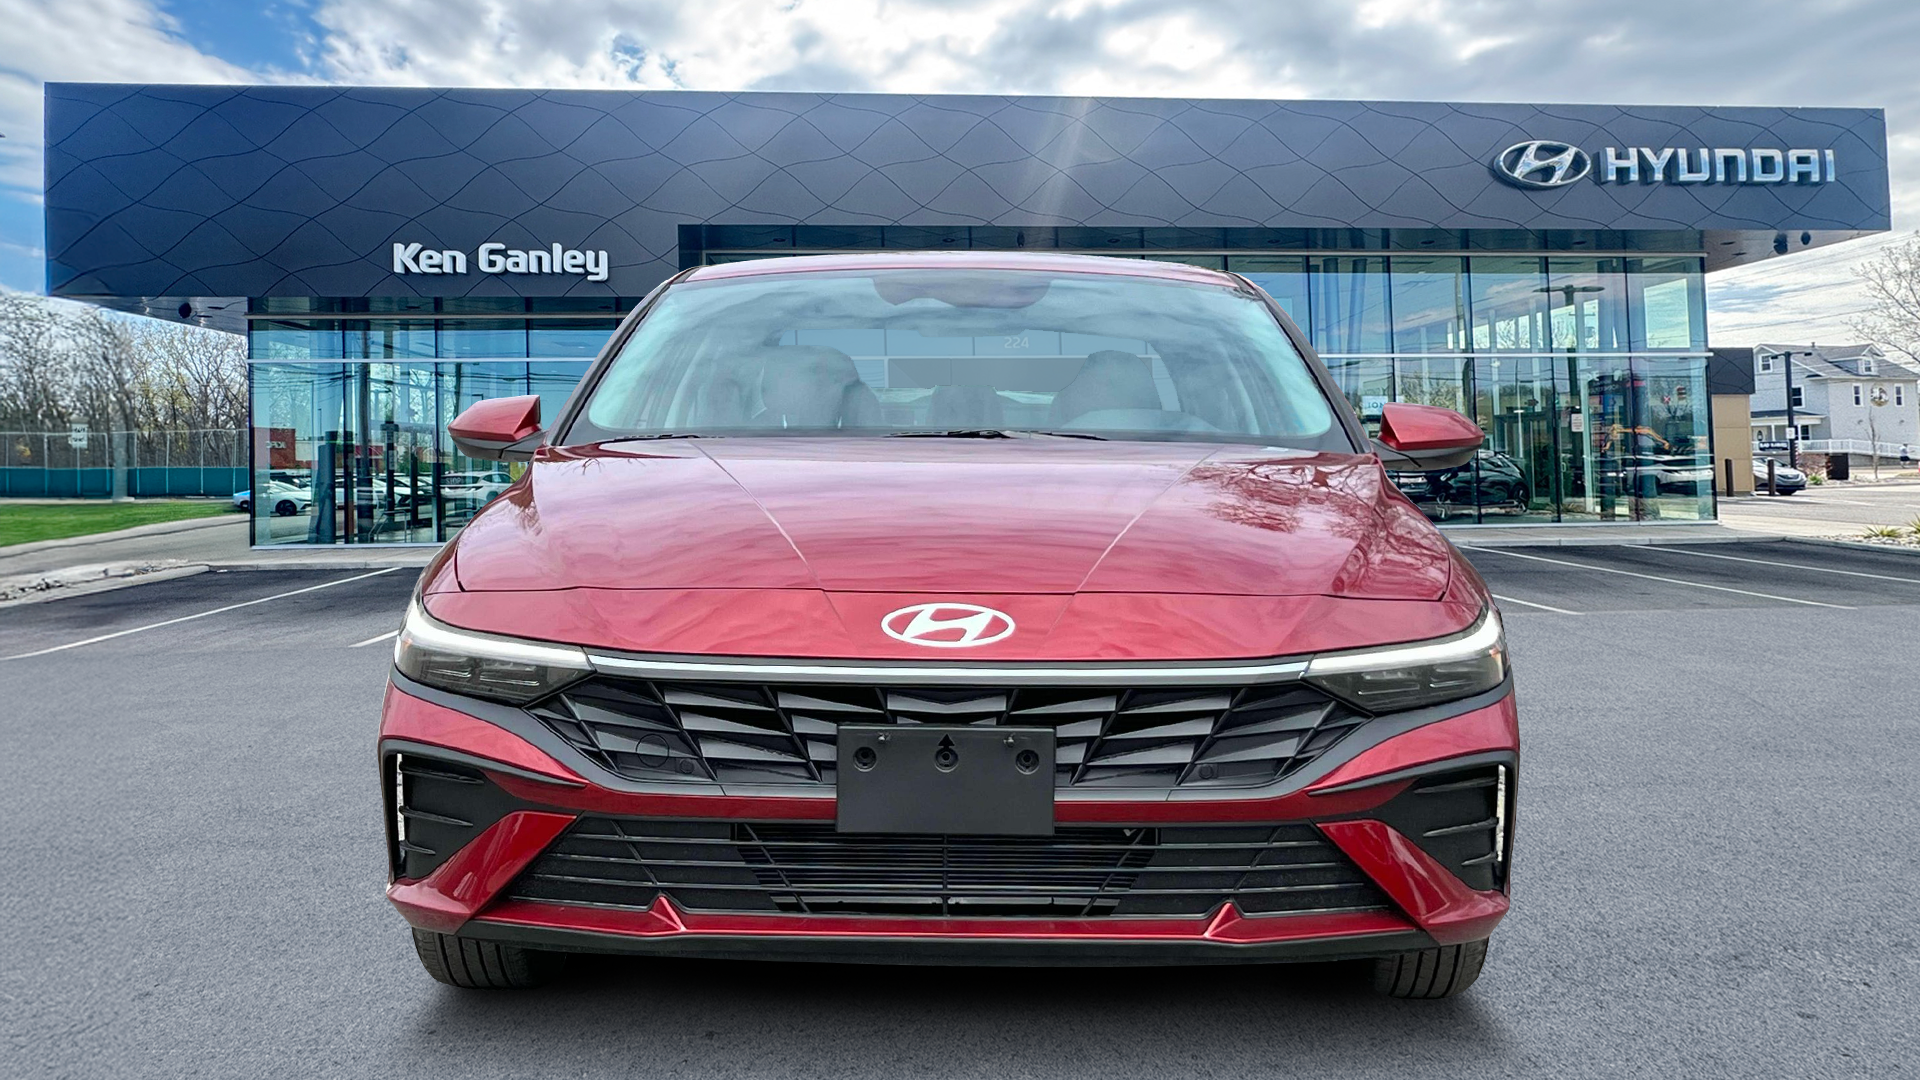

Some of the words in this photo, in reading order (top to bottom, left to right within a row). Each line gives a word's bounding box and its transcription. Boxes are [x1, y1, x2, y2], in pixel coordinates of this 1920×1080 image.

[1604, 147, 1836, 184] HYUNDAI
[393, 242, 467, 274] Ken
[477, 242, 609, 280] Ganley
[1004, 336, 1029, 349] 224
